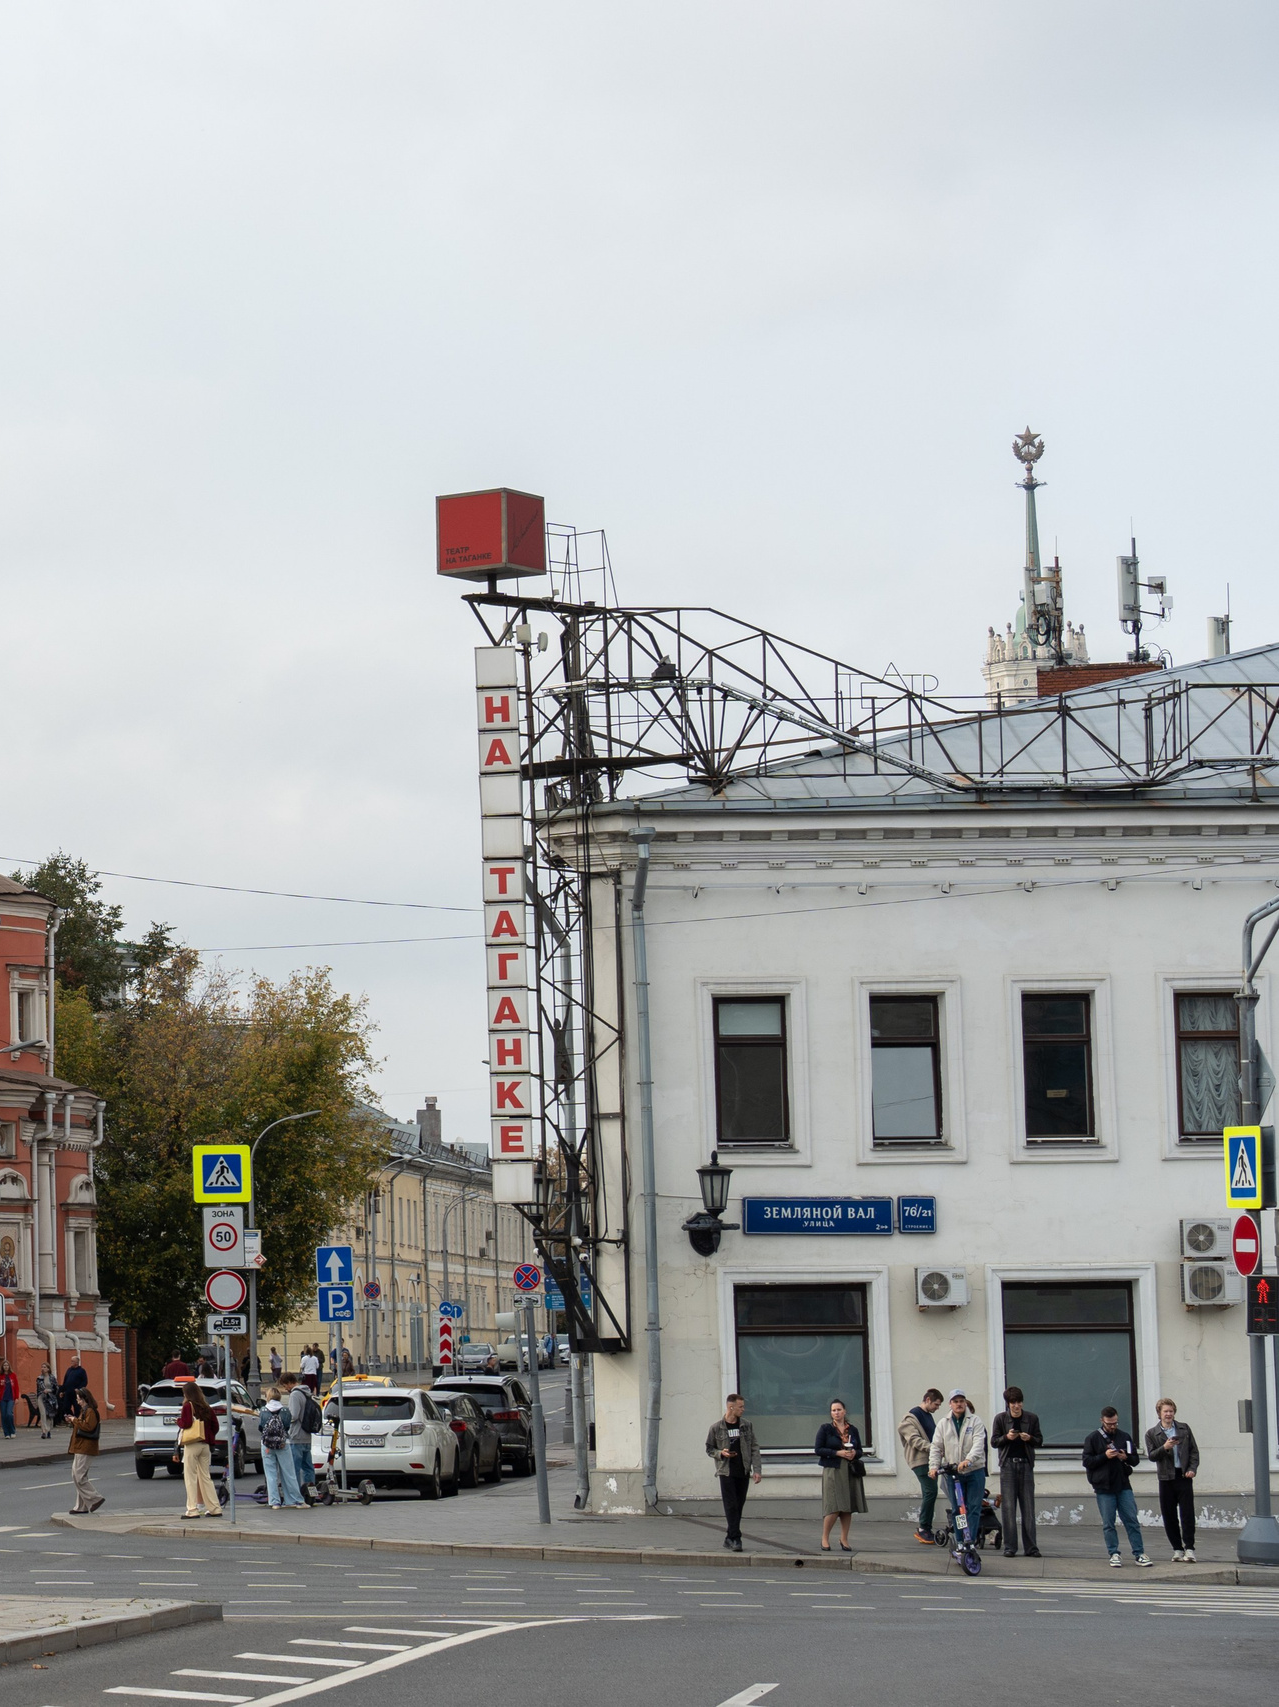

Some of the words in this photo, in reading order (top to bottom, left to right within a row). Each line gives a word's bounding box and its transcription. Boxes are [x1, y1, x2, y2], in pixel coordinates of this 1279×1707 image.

[446, 546, 470, 556] ТЕАТР
[446, 556, 457, 564] НА
[459, 552, 492, 563] ТАГАНКЕ
[484, 696, 512, 766] НА
[489, 867, 525, 1153] ТАГАНКЕ
[211, 1210, 235, 1218] ЗОНА
[764, 1205, 843, 1219] ЗЕМЛЯНОЙ
[847, 1207, 875, 1219] ВАЛ
[903, 1206, 932, 1218] 76/21
[803, 1220, 835, 1228] УЛИЦА
[215, 1231, 232, 1243] 50
